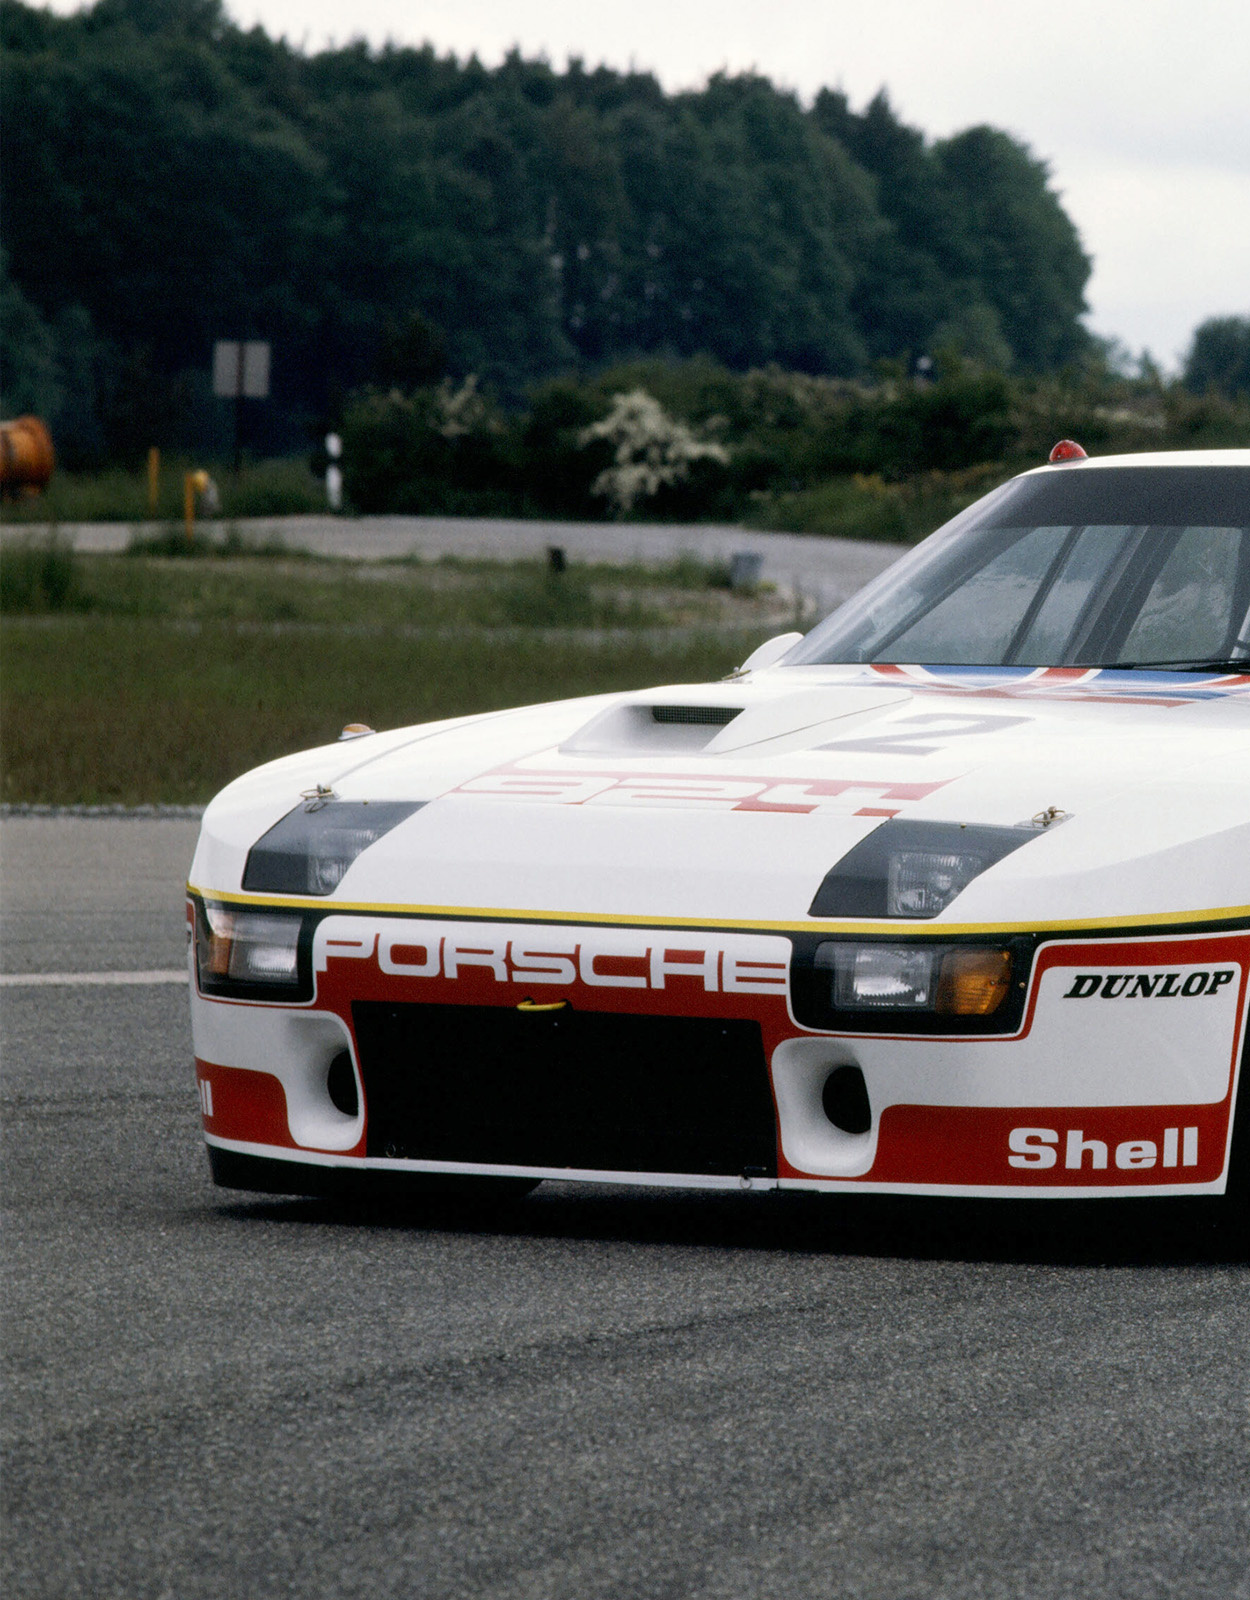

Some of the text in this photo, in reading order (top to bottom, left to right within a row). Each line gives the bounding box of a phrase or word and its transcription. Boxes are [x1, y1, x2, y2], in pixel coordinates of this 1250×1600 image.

[811, 713, 1036, 756] 2
[315, 928, 787, 995] PORSCHE
[1063, 970, 1235, 999] DUNLOP
[1008, 1126, 1199, 1170] Shell
